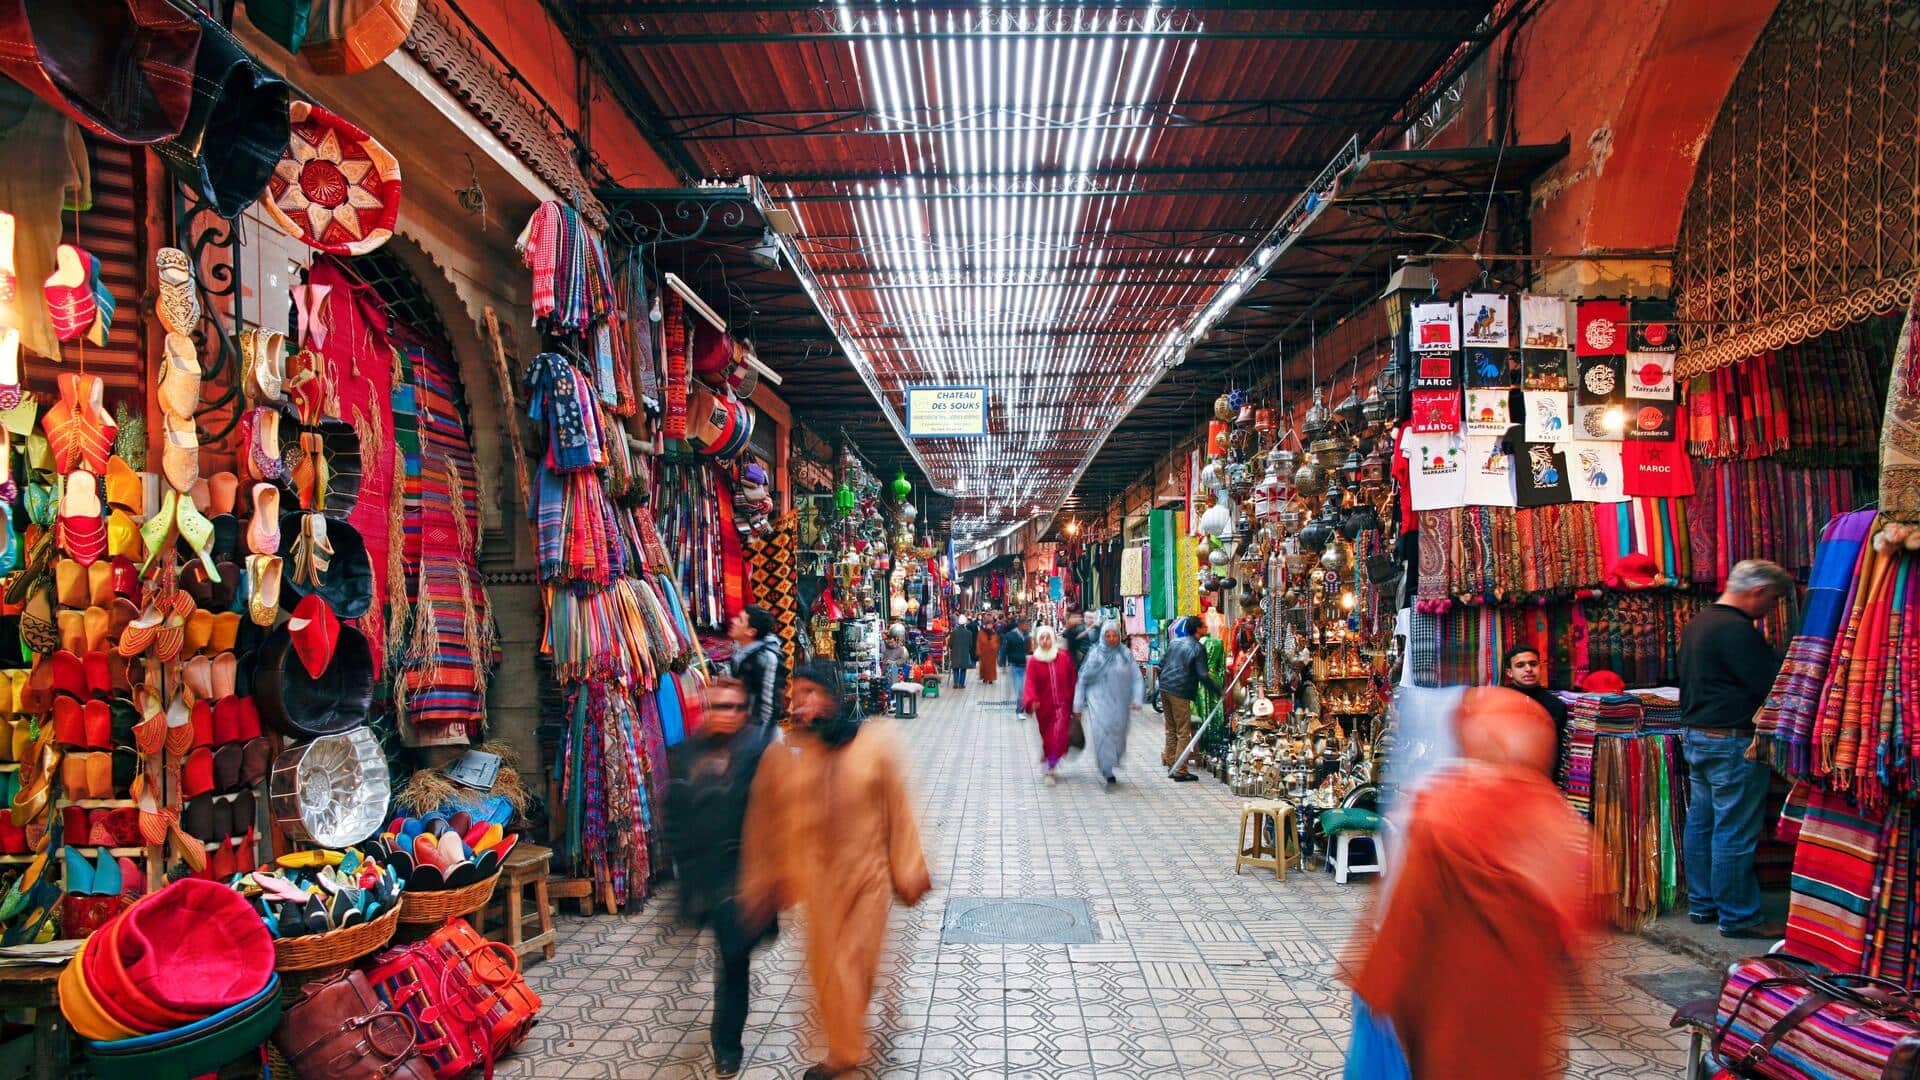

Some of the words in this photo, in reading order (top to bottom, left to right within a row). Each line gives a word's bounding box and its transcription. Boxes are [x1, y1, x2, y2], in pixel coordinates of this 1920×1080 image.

[1639, 344, 1676, 352] Marrakech
[1632, 385, 1671, 393] Marrakech
[1639, 464, 1671, 473] MAROC
